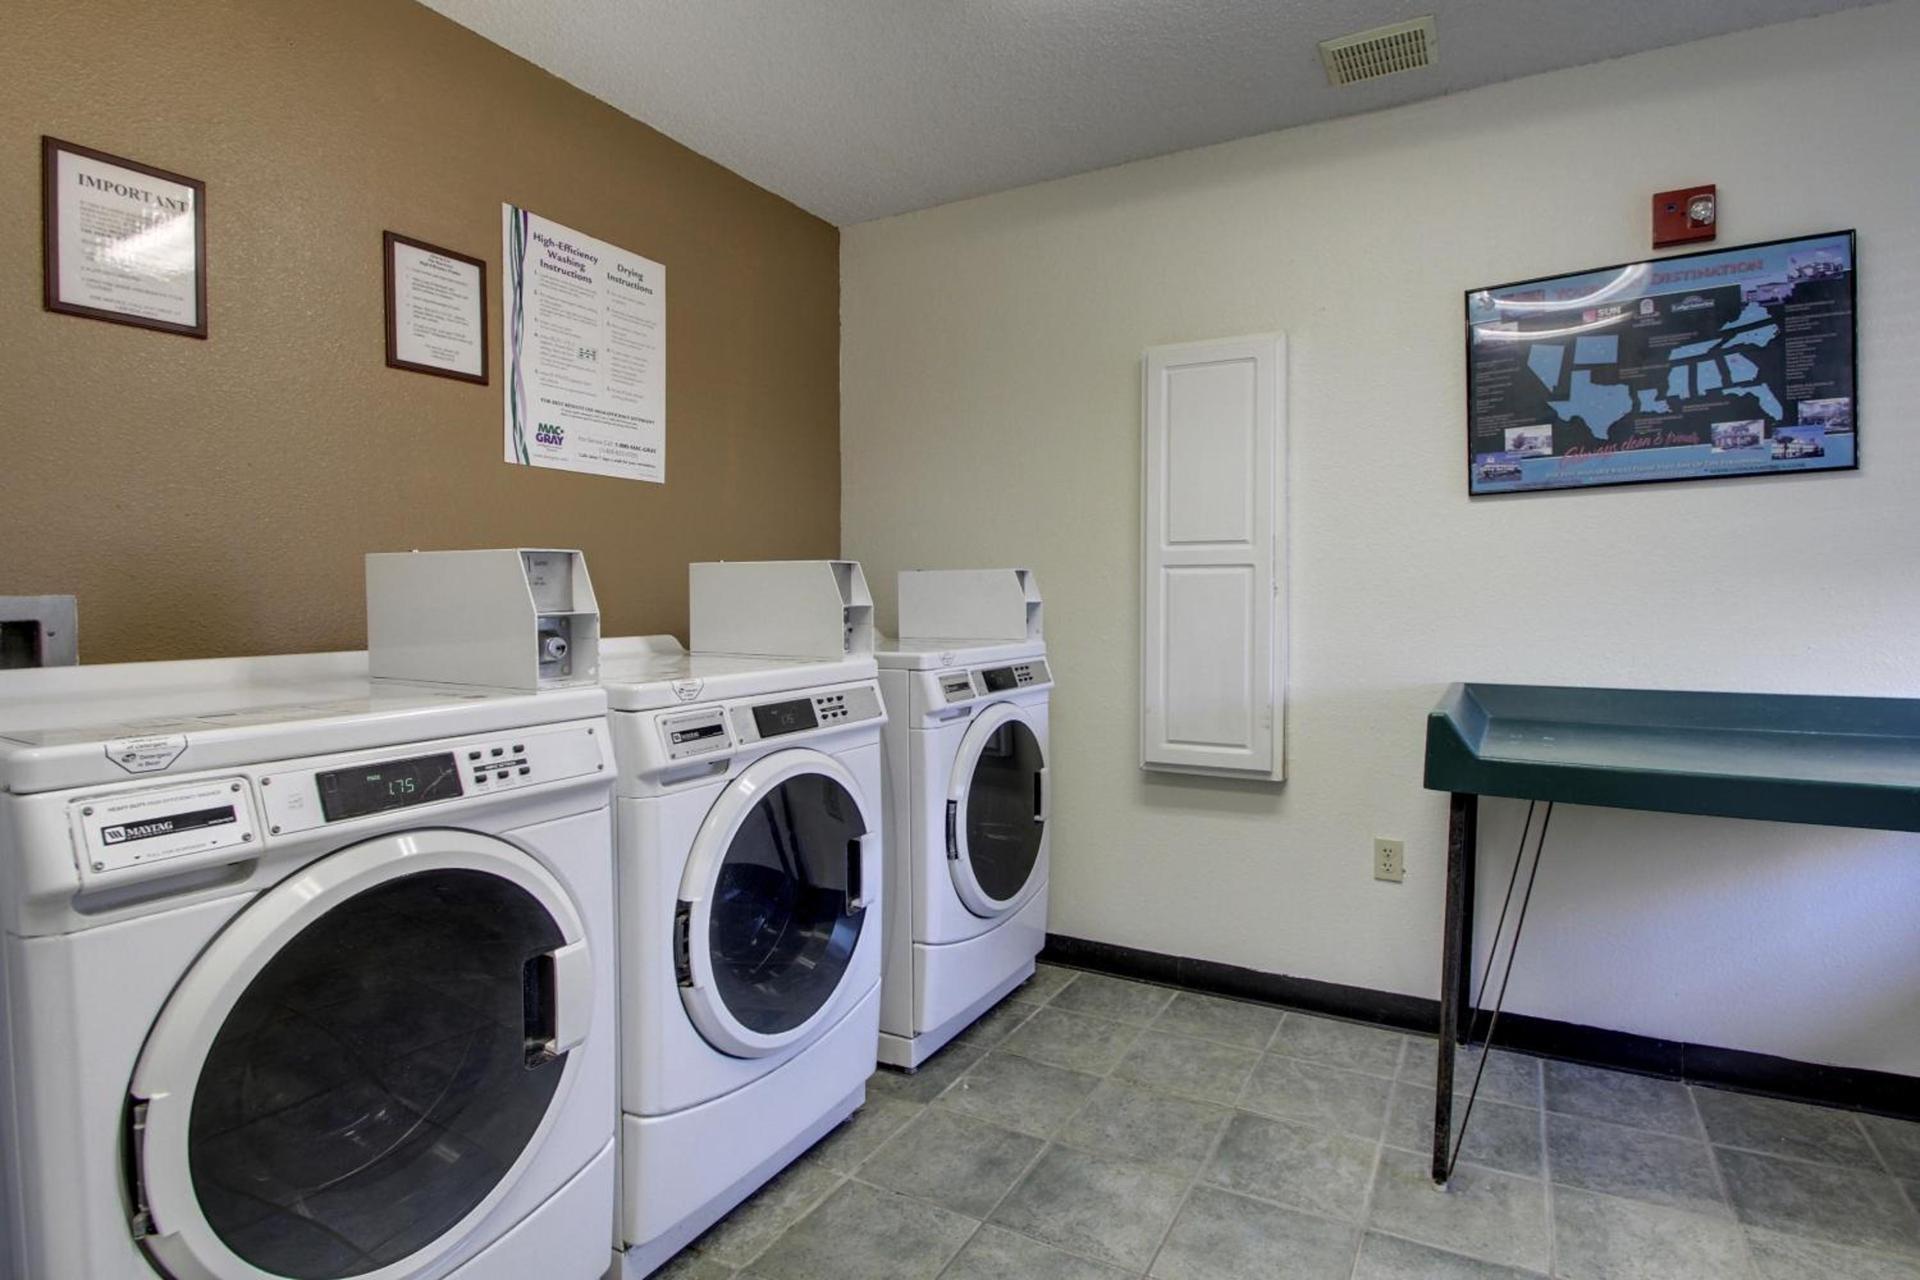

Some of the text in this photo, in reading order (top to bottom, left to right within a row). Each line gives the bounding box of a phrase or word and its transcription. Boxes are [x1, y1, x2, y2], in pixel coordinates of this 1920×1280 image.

[78, 173, 187, 213] IMPORTANT
[533, 231, 599, 266] High-Efficiency
[540, 258, 594, 284] Instructions
[547, 249, 586, 273] Washing
[617, 263, 644, 282] Drying
[607, 272, 653, 295] Instructions
[535, 433, 564, 446] GRAY
[125, 821, 174, 837] MAYTAG
